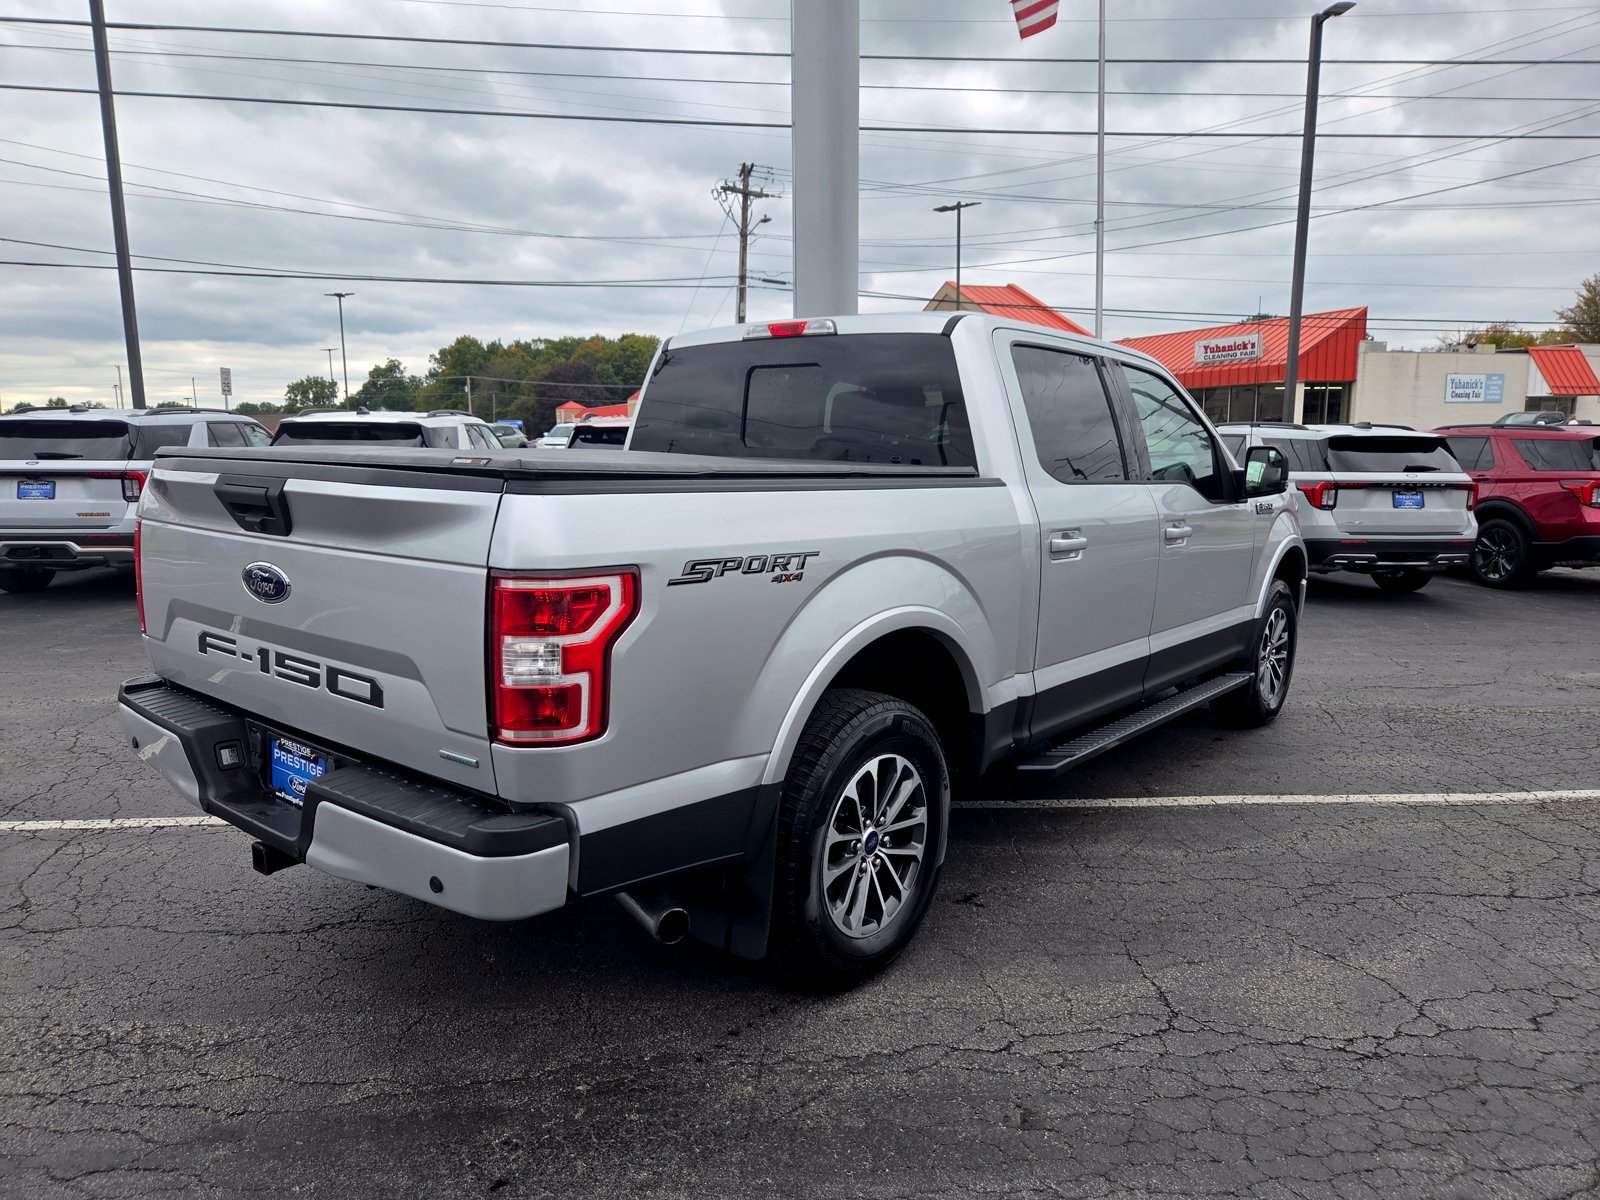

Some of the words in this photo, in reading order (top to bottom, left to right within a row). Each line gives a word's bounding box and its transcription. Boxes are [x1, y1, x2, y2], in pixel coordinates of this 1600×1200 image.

[1202, 340, 1256, 354] Yuhanick's
[1203, 351, 1238, 360] CLEANING
[1450, 378, 1484, 389] Yuhanick's
[1451, 390, 1471, 399] Cleaning
[666, 551, 820, 587] SPORT
[249, 569, 276, 595] Ford
[197, 630, 385, 711] F-150
[280, 738, 311, 755] PRESTIGE
[274, 748, 323, 777] PRESTIGE
